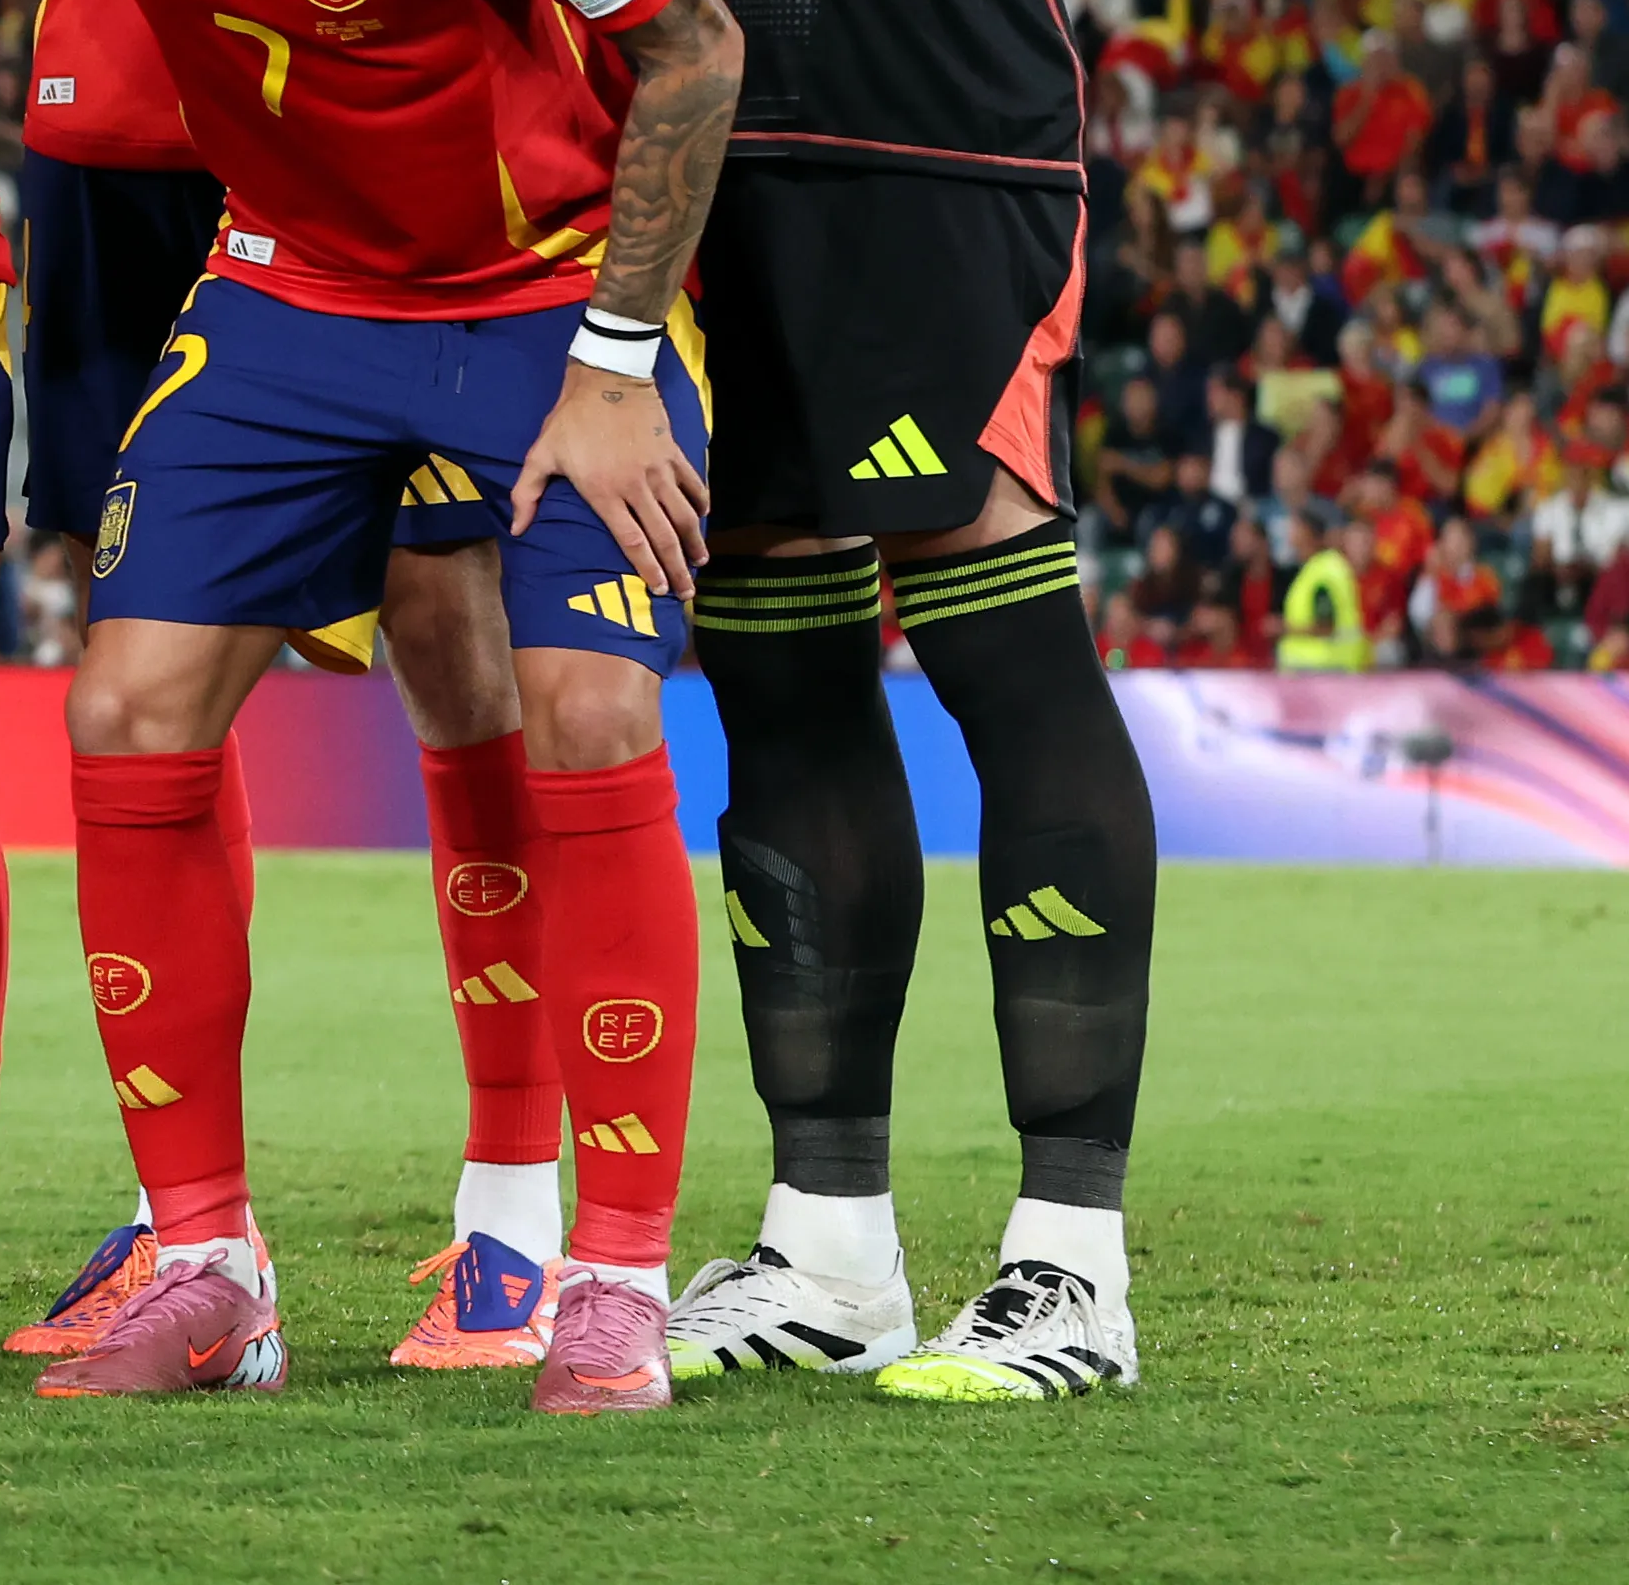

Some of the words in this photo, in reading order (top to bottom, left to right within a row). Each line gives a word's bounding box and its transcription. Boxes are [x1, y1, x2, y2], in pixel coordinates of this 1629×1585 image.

[213, 12, 291, 118] 7
[117, 332, 209, 454] 7
[93, 965, 126, 984] RF
[93, 984, 128, 1001] EF
[600, 1013, 645, 1029] RF
[598, 1032, 643, 1049] EF
